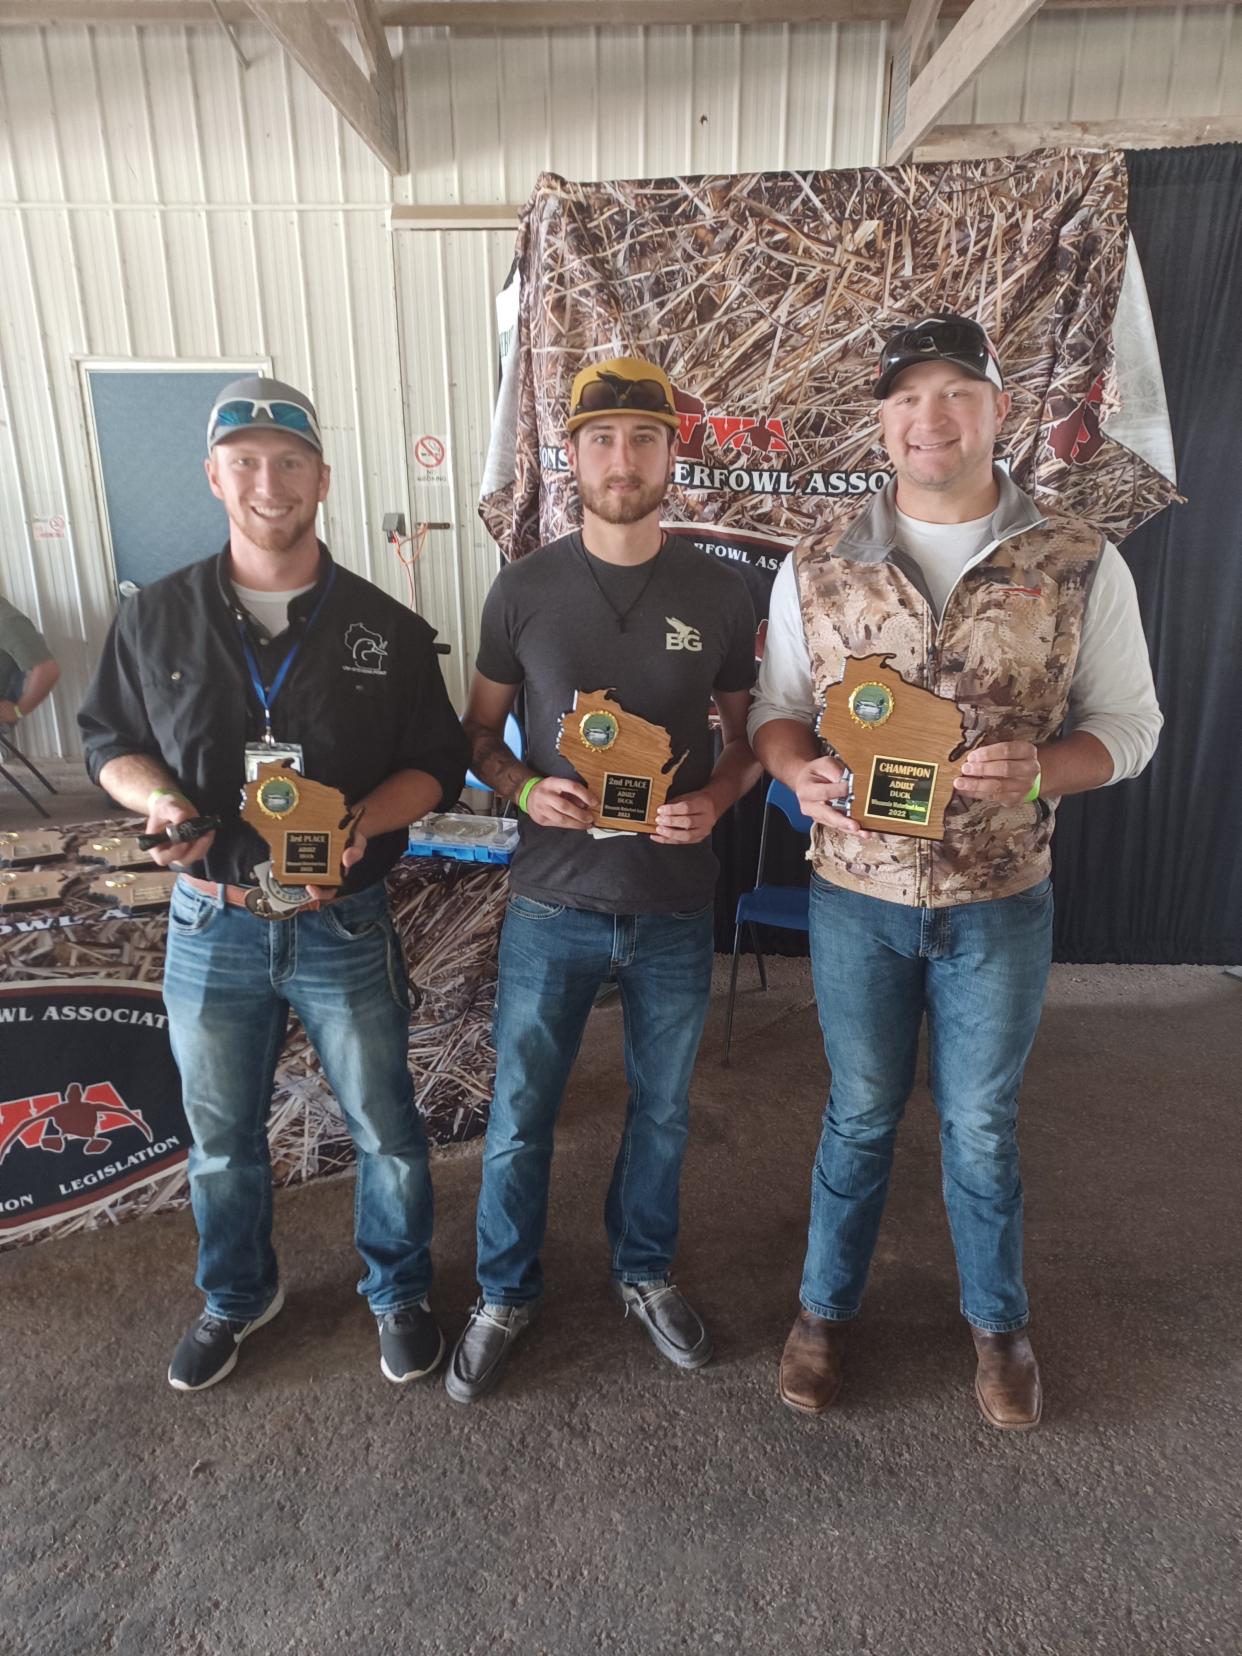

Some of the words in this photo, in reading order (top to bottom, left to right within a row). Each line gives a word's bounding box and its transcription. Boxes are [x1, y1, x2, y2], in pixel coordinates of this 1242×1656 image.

[879, 762, 931, 779] CHAMPION
[608, 777, 623, 787] 2nd
[624, 779, 648, 789] PLACE
[889, 780, 915, 791] ADULT
[889, 790, 911, 799] DUCK
[888, 809, 907, 818] 2022
[59, 1136, 181, 1196] LEGISLATION
